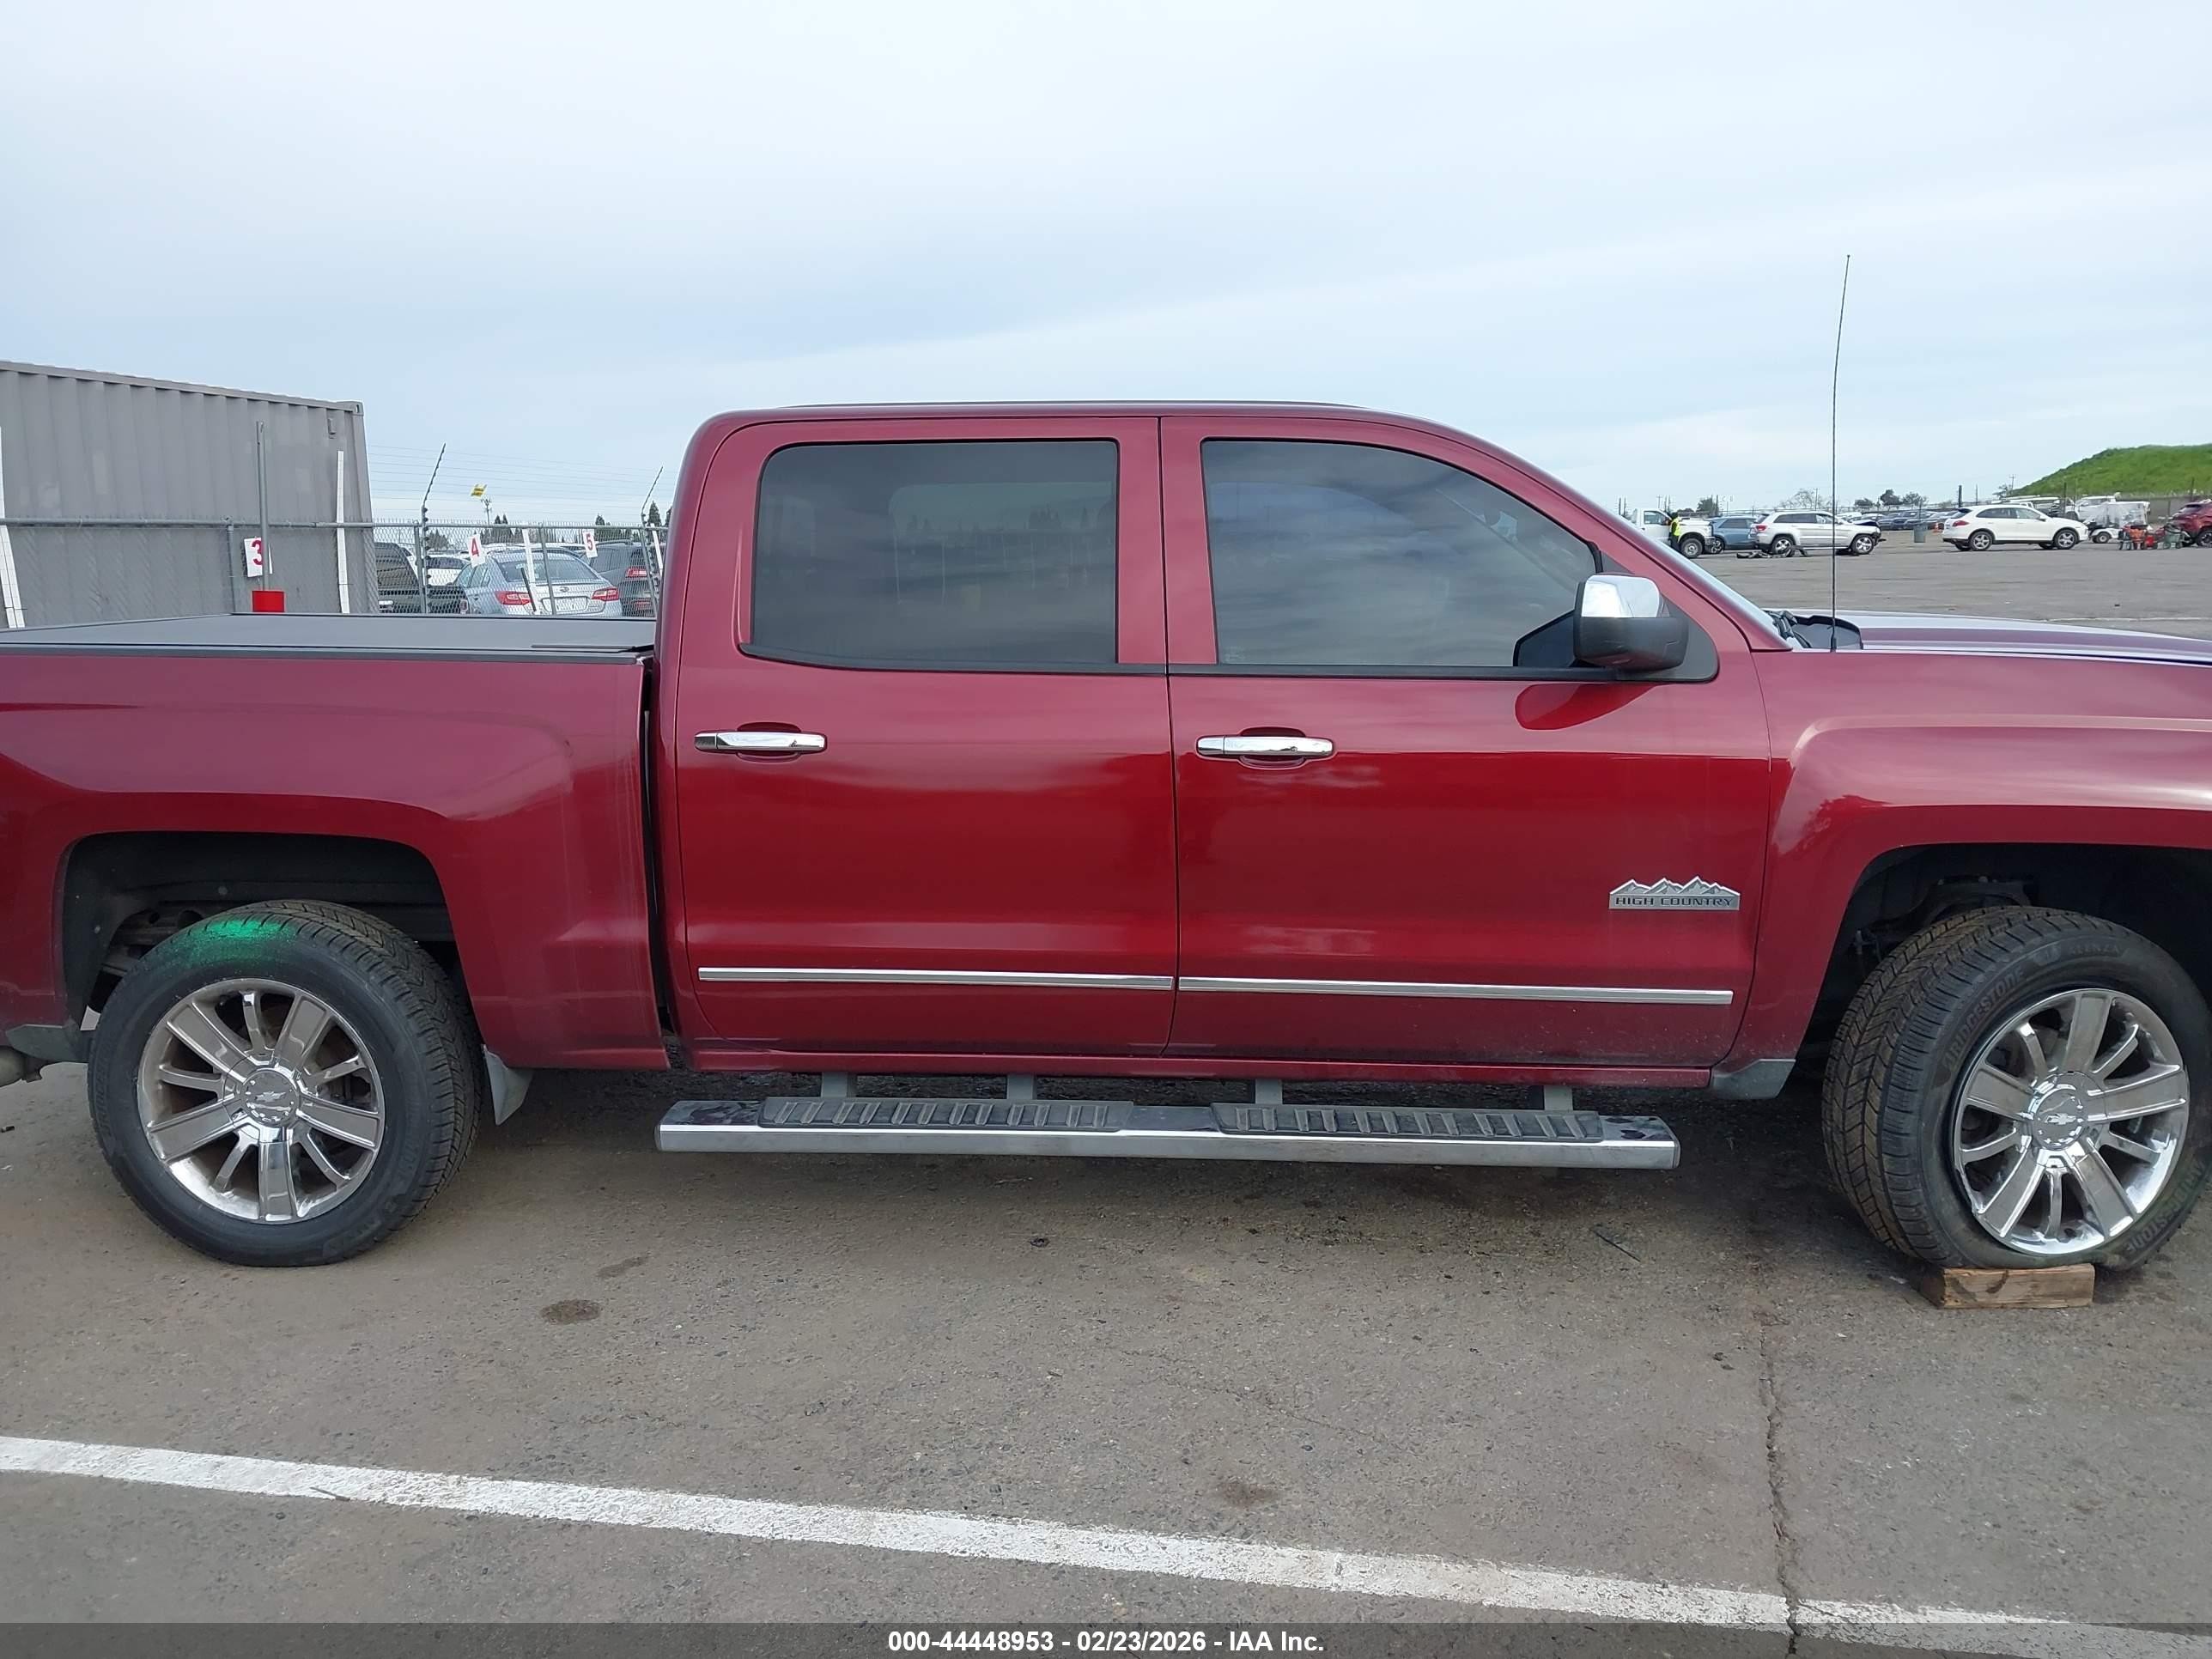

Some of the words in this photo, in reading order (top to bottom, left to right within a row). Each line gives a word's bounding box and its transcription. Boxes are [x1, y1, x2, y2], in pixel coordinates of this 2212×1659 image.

[471, 537, 480, 557] 4
[586, 532, 593, 551] 5
[251, 539, 263, 566] 3
[1614, 896, 1654, 906] HIGH
[1661, 897, 1734, 907] COUNTRY
